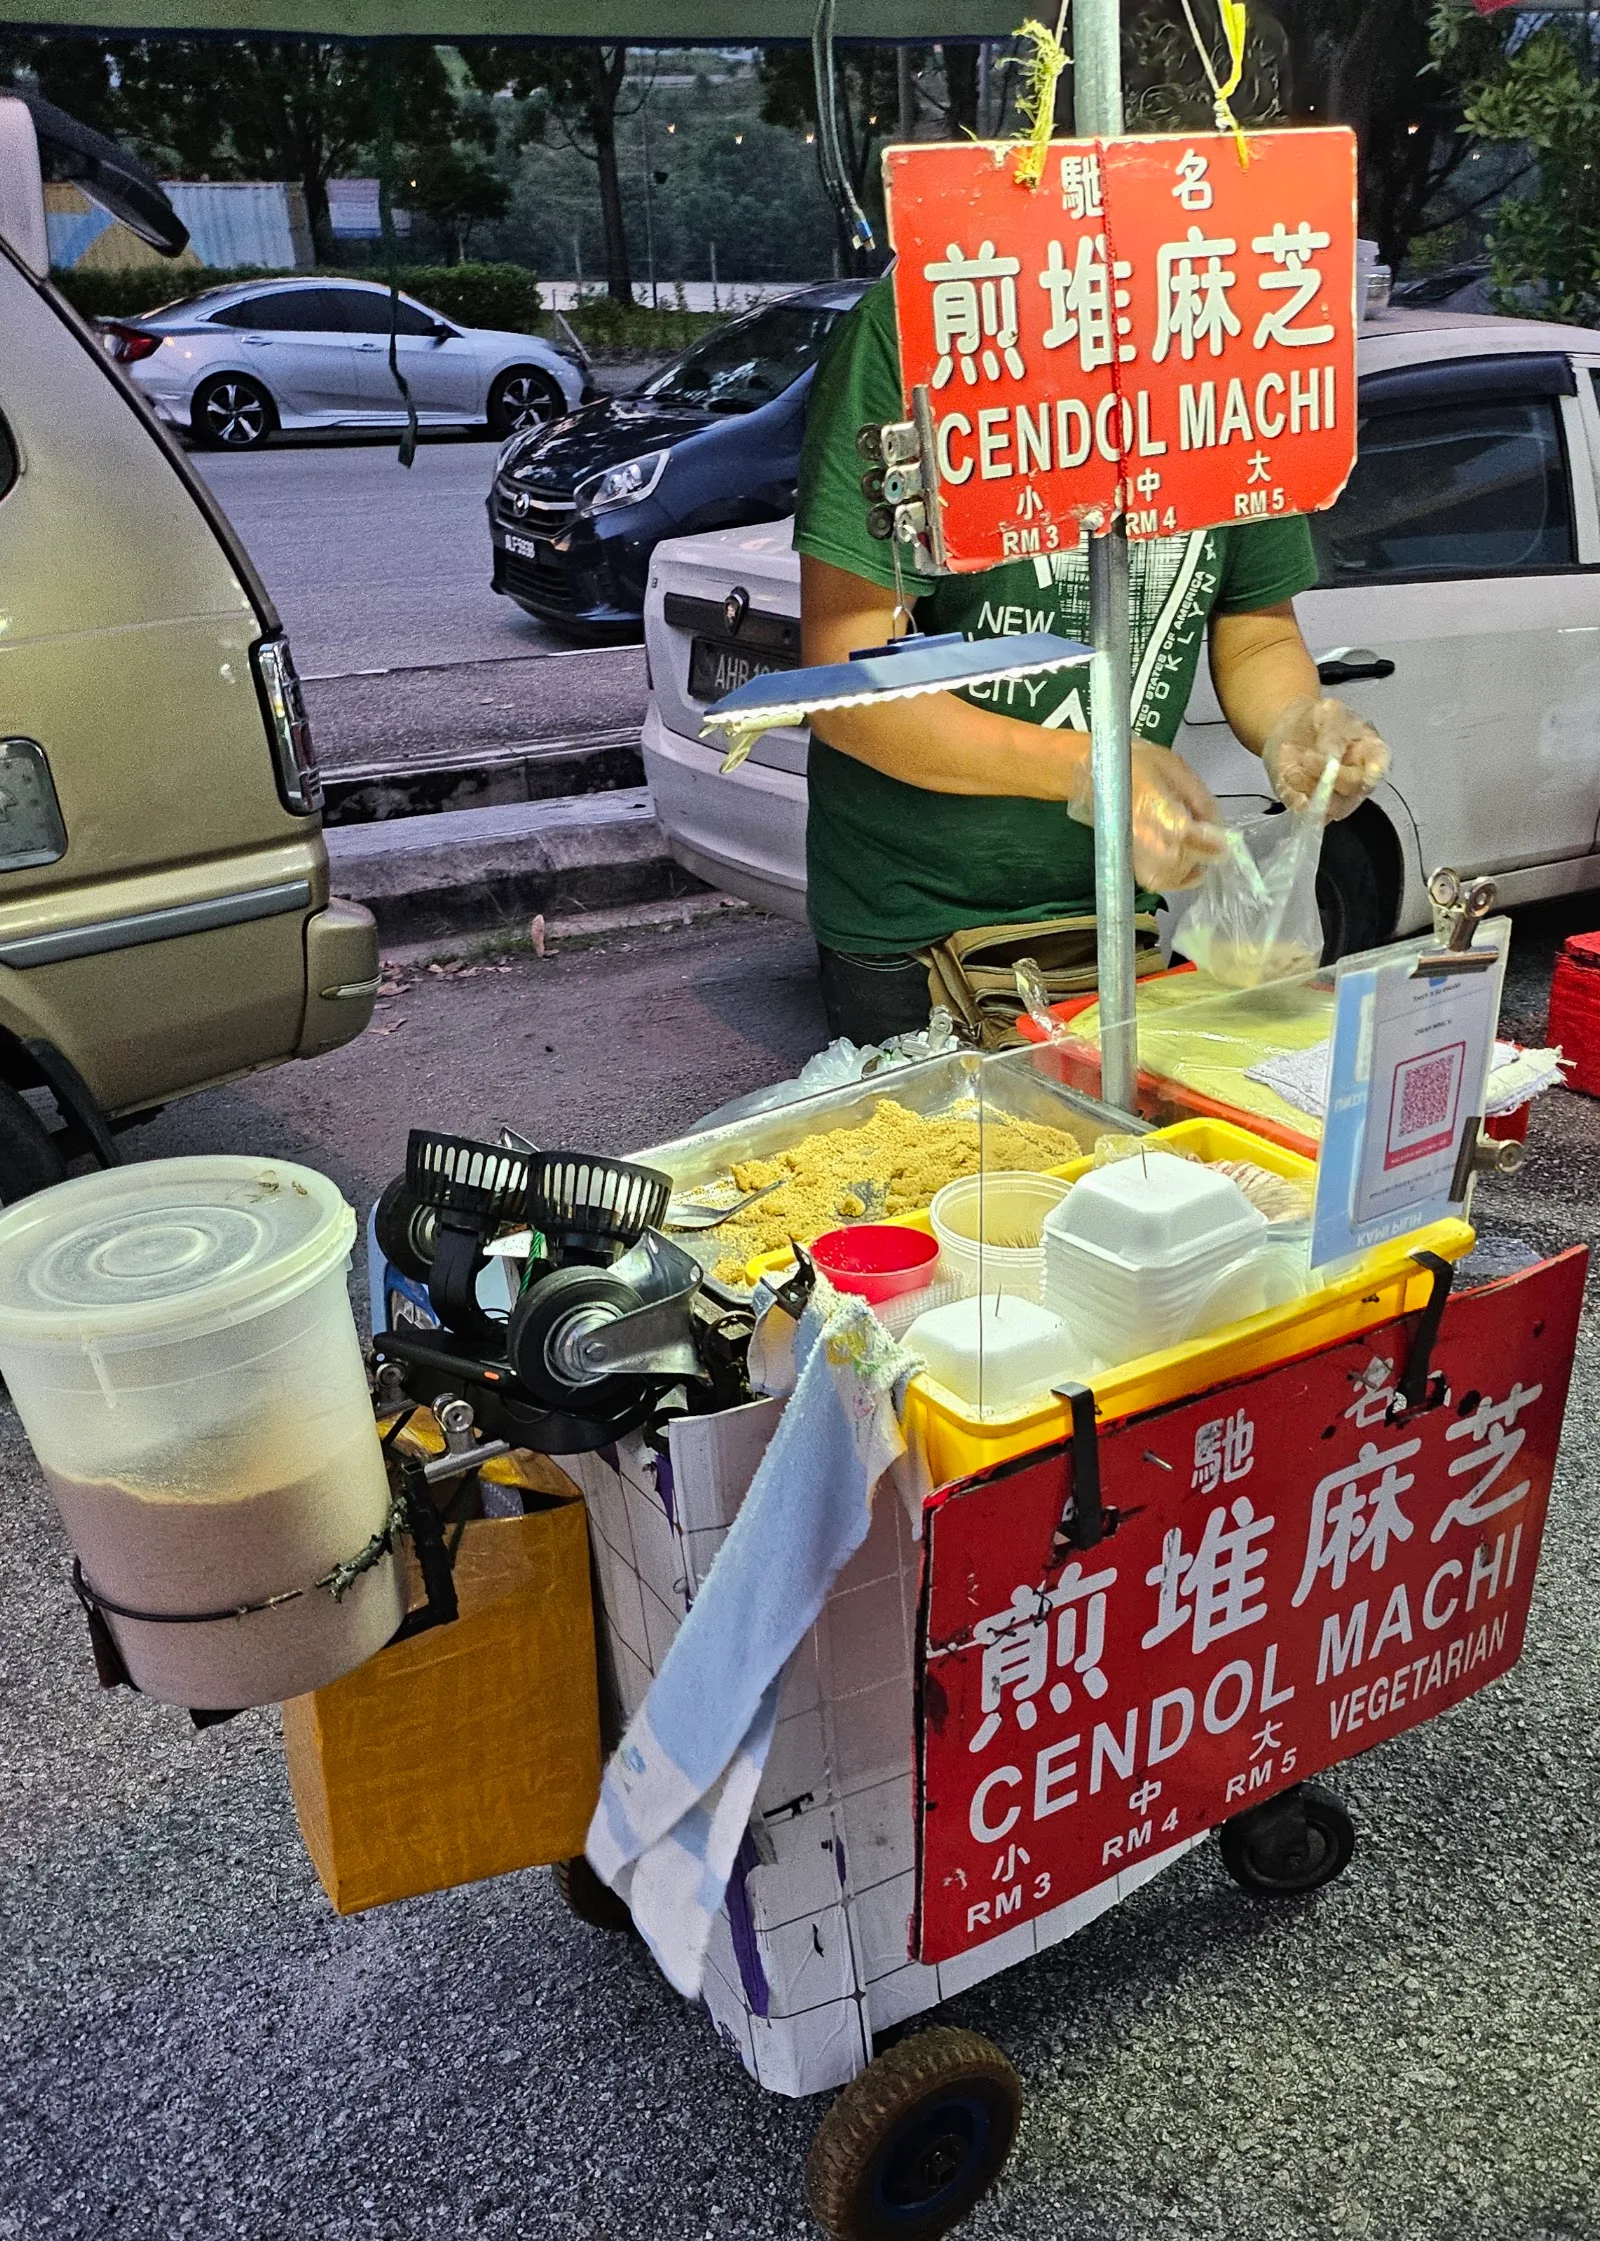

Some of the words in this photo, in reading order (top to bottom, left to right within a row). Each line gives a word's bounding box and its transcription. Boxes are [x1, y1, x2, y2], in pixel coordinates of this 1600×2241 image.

[923, 221, 1336, 390] 煎堆麻芝
[937, 390, 1168, 485] CENDOL
[1178, 365, 1337, 452] MACHI
[1136, 467, 1162, 502] 中
[1247, 450, 1272, 485] 大
[1016, 486, 1044, 521] 小
[1234, 492, 1267, 516] RM
[1271, 487, 1285, 510] 5
[1002, 528, 1041, 556] RM
[1046, 524, 1060, 549] 3
[1126, 512, 1159, 536] RM
[1161, 510, 1177, 530] 4
[978, 601, 1055, 636] NEW
[1173, 571, 1206, 631] AMERICA
[968, 677, 1048, 708] CITY
[969, 1383, 1543, 1753] 煎堆麻芝
[969, 1643, 1294, 1843] CENDOL
[1316, 1524, 1523, 1686] MACHI
[1328, 1612, 1510, 1741] VEGETARIAN
[1250, 1720, 1284, 1762] 大
[1225, 1763, 1273, 1804] RM
[1280, 1746, 1298, 1774] 5
[1128, 1778, 1163, 1816] 中
[1101, 1820, 1152, 1867] RM
[1159, 1812, 1179, 1837] 4
[992, 1843, 1030, 1882] 小
[966, 1883, 1022, 1932] RM
[1033, 1871, 1053, 1900] 3
